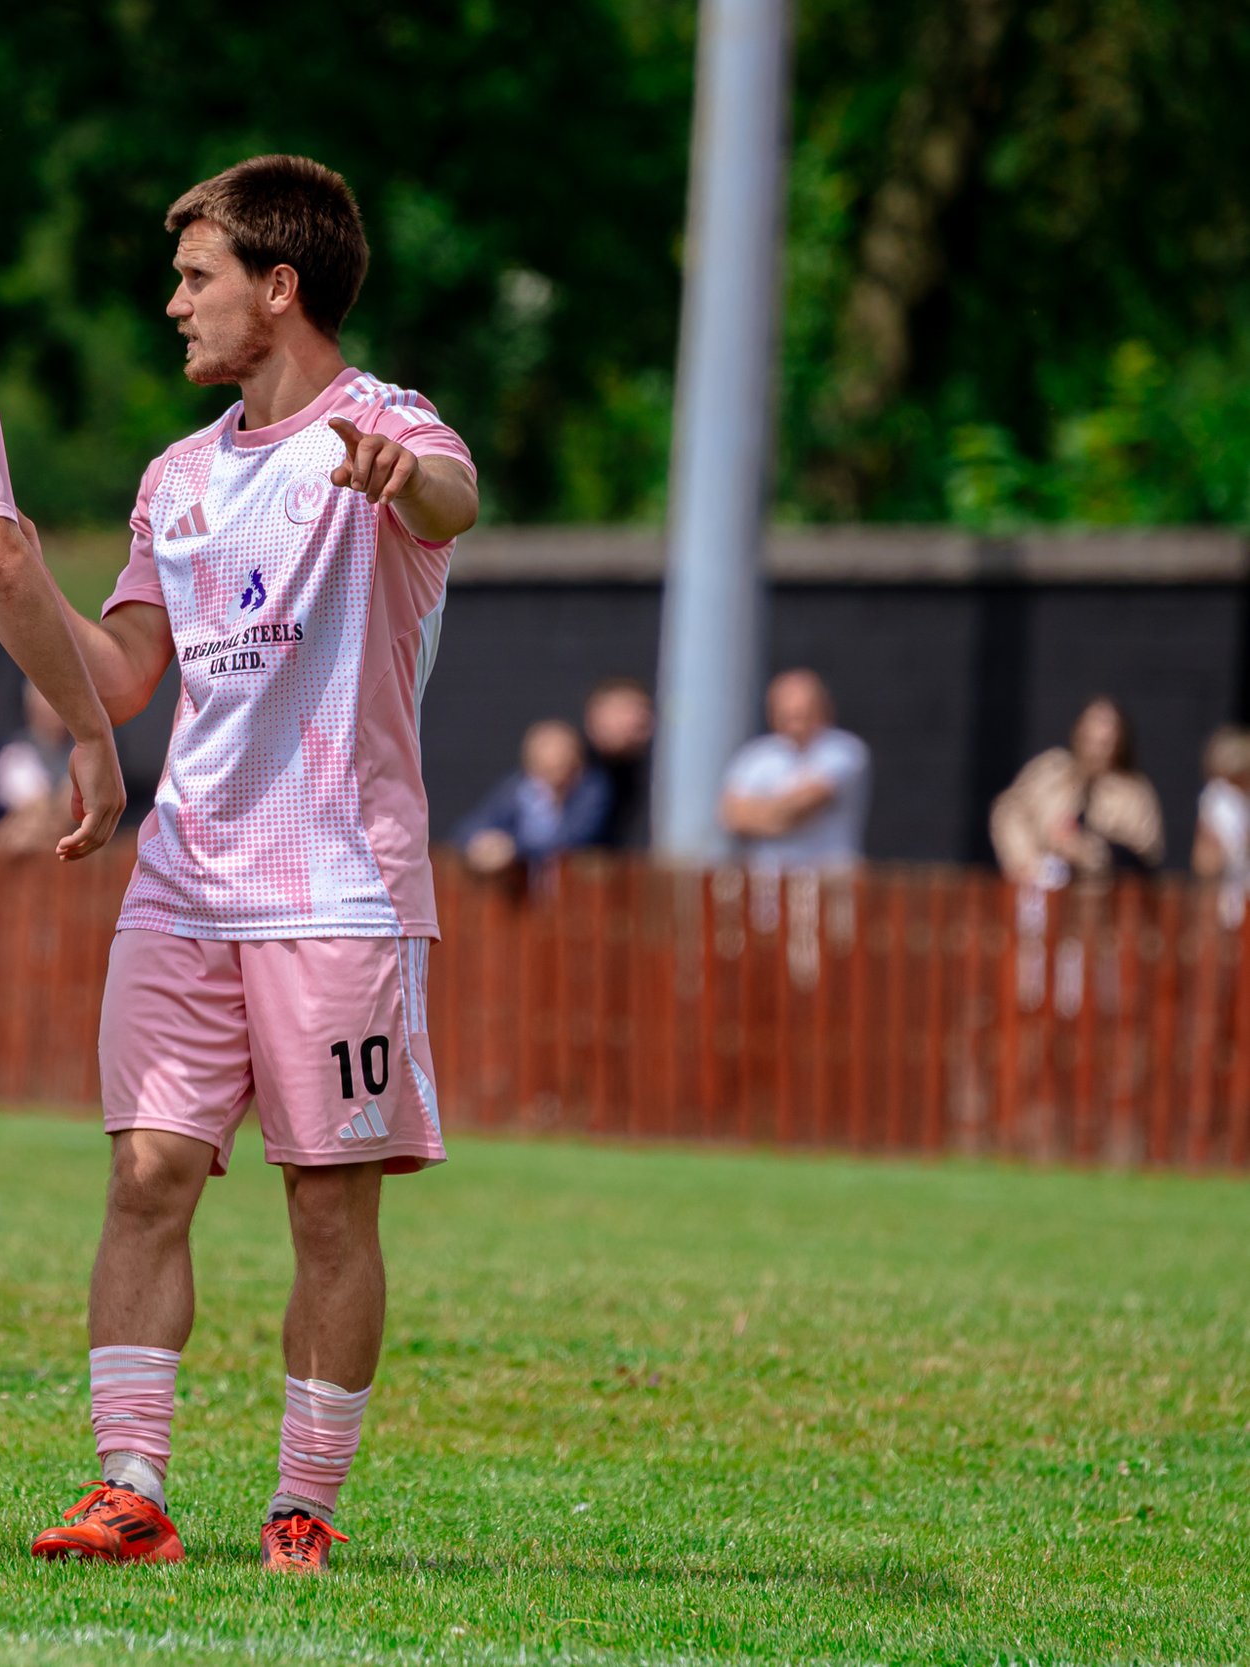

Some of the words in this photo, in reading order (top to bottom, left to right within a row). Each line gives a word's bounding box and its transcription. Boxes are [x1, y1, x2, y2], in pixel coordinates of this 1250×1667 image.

[242, 623, 303, 644] STEELS
[210, 655, 228, 675] UK
[231, 651, 266, 671] LTD.
[331, 1035, 389, 1099] 10
